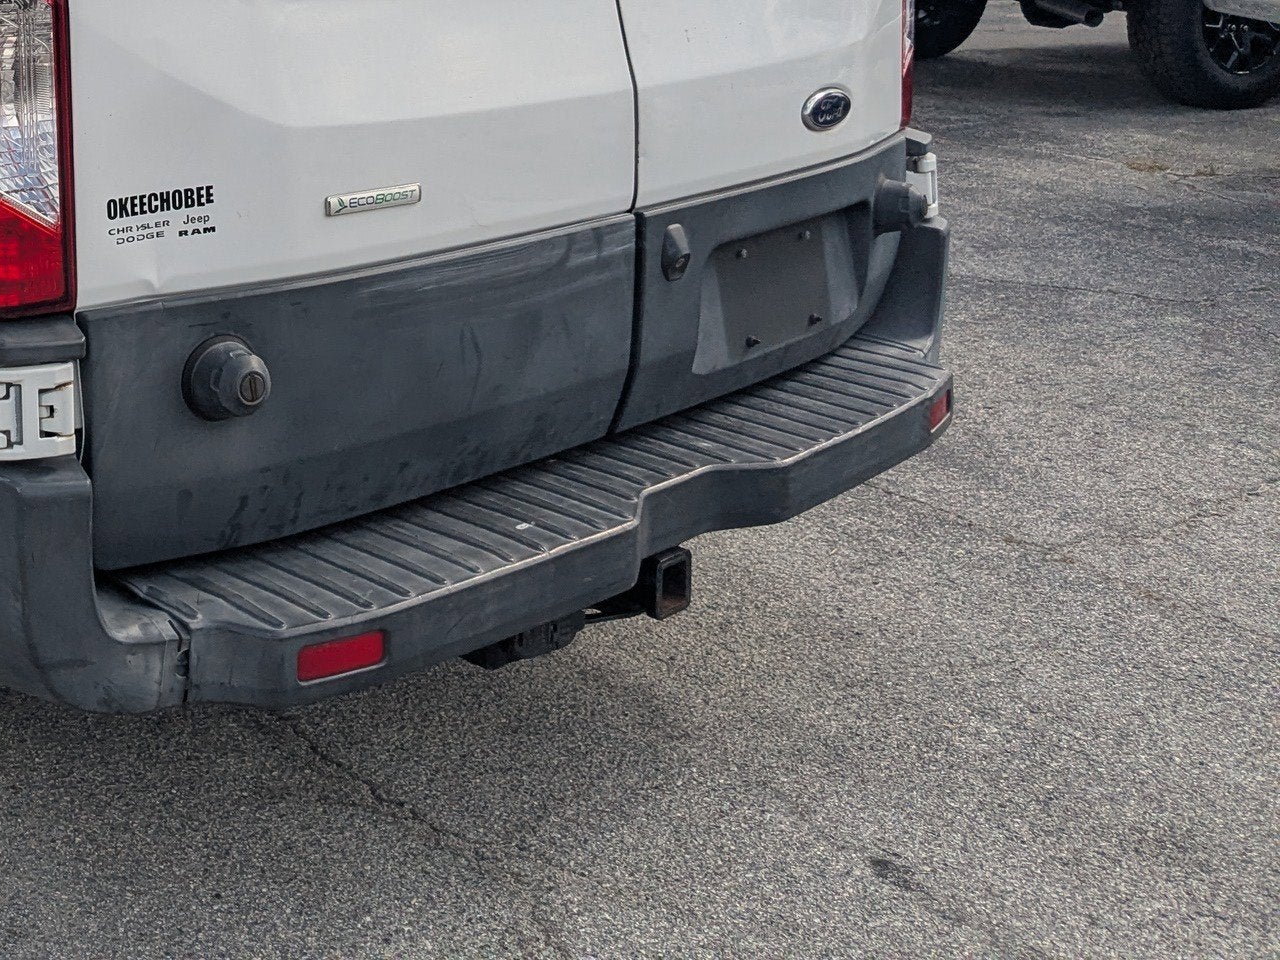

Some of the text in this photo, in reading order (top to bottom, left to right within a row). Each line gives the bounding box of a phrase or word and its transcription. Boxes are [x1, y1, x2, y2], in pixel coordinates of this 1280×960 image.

[106, 185, 215, 220] OKEECHOBEE
[108, 214, 210, 236] CHRYSLER Jeep
[116, 226, 216, 245] DODGE RAM
